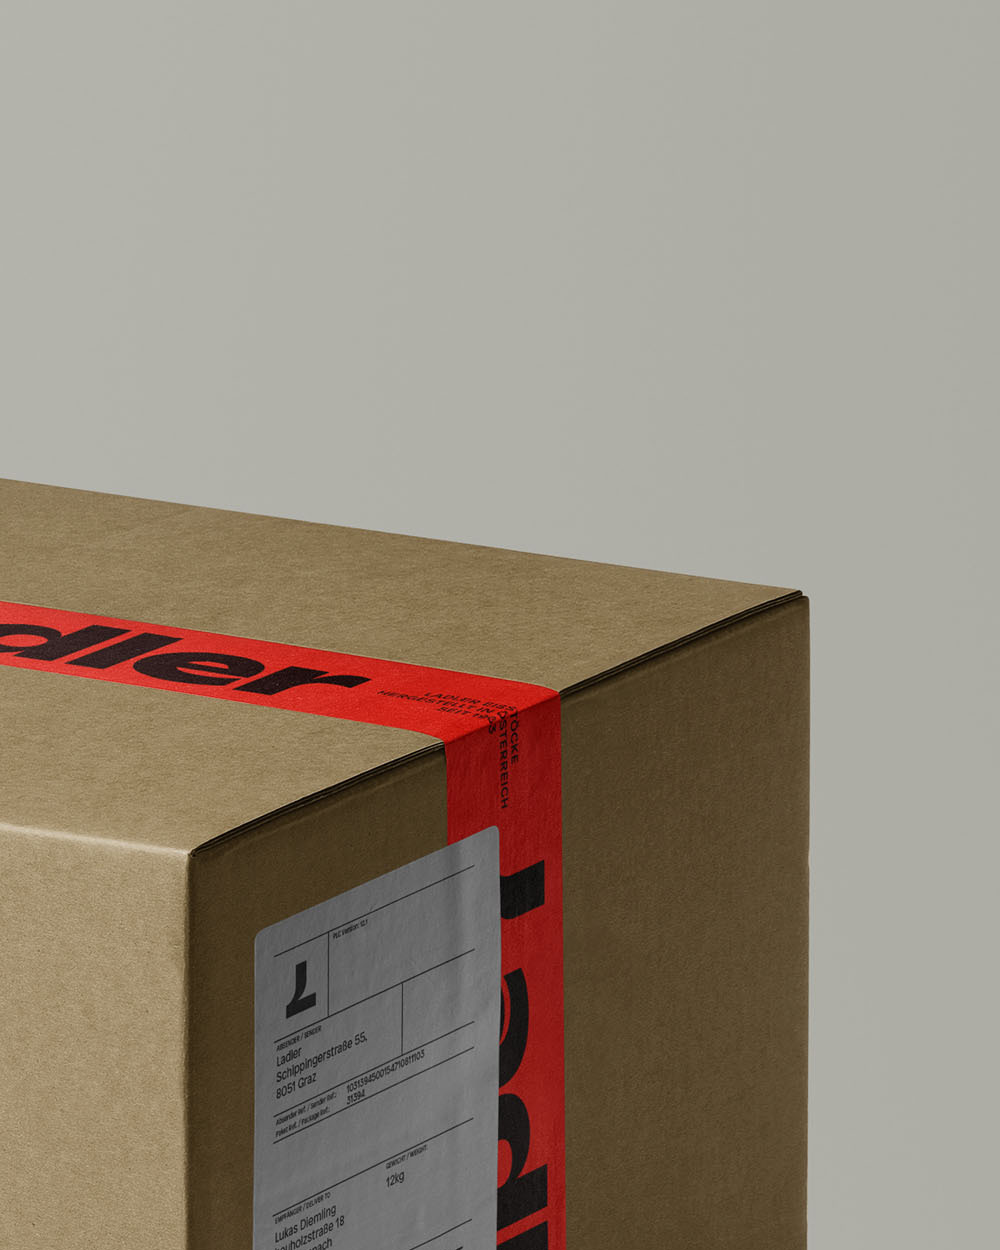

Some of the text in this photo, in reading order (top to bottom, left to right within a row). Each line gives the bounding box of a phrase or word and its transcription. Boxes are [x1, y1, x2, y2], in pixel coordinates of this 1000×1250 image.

[377, 690, 477, 709] HERGESTELLT
[423, 692, 481, 704] LADLER
[436, 706, 473, 716] SEIT
[276, 1039, 353, 1082] Schippingerstraße
[277, 1047, 302, 1067] Ladler
[276, 1073, 317, 1099] 8051 Graz
[346, 1089, 366, 1105] 31394
[386, 1171, 405, 1188] 12kg
[275, 1205, 337, 1243] Lukas Diemling
[335, 1215, 345, 1228] 18
